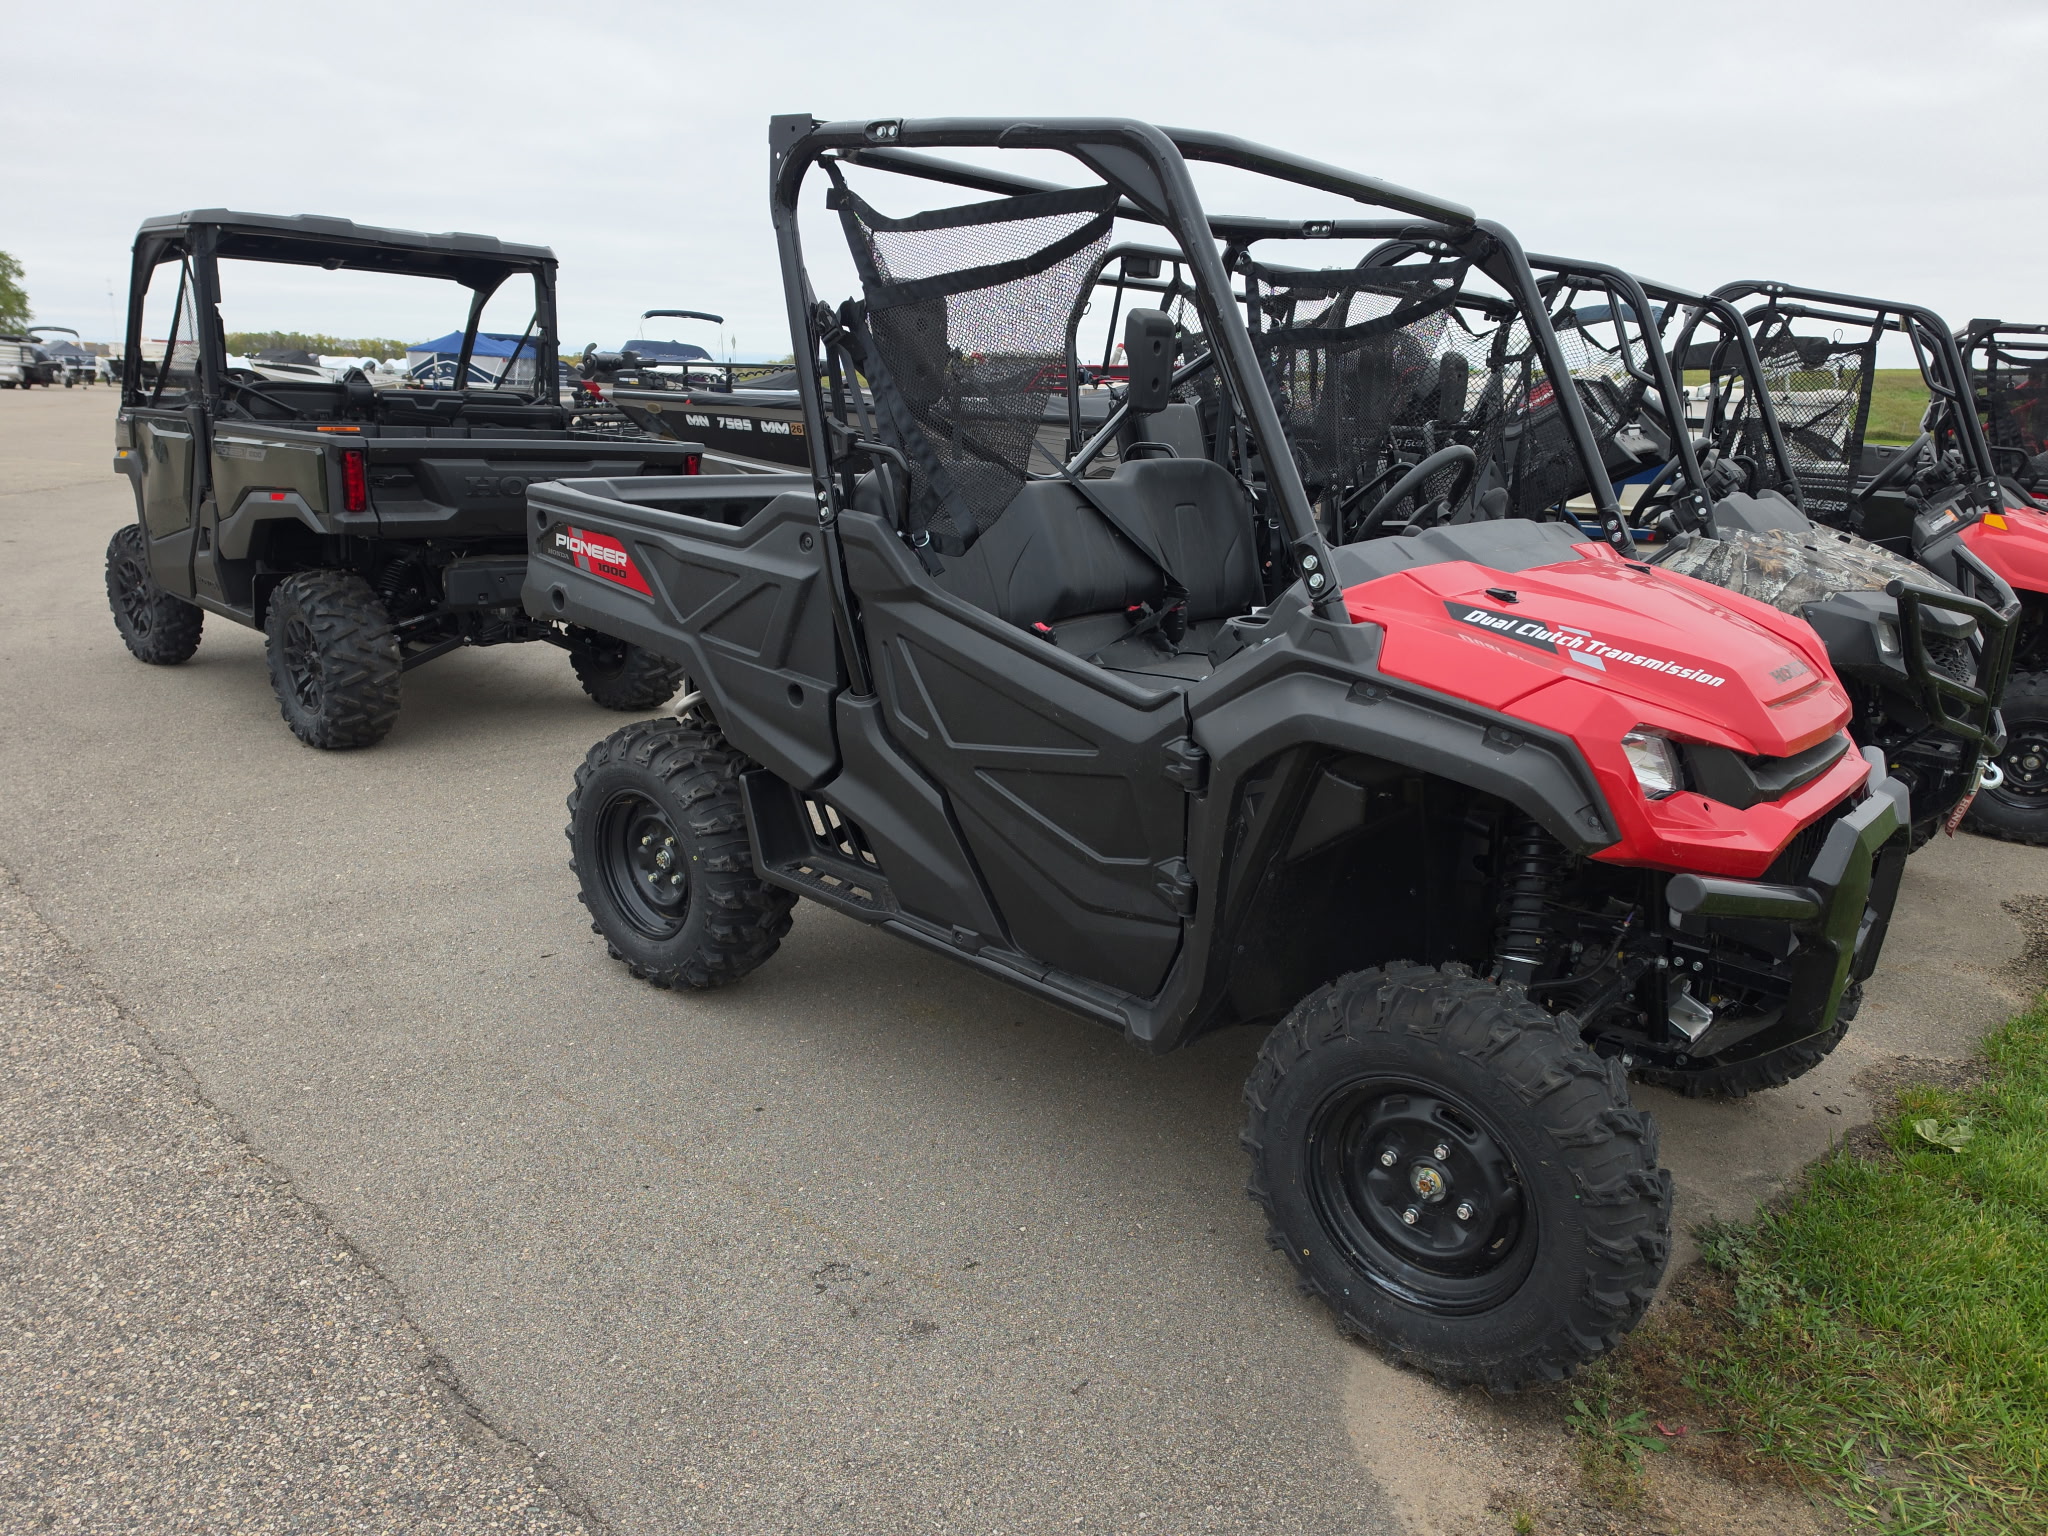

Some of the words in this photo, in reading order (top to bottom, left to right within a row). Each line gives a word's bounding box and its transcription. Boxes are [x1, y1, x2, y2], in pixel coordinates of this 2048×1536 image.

[685, 413, 710, 427] MN
[716, 416, 752, 431] 7585
[760, 420, 790, 435] MM
[791, 424, 803, 434] 26
[547, 547, 570, 560] HONDA
[555, 532, 627, 567] PIONEER
[598, 562, 627, 579] 1000
[1463, 609, 1519, 631] Dual
[1515, 623, 1585, 649] Clutch
[1584, 640, 1726, 688] Transmission
